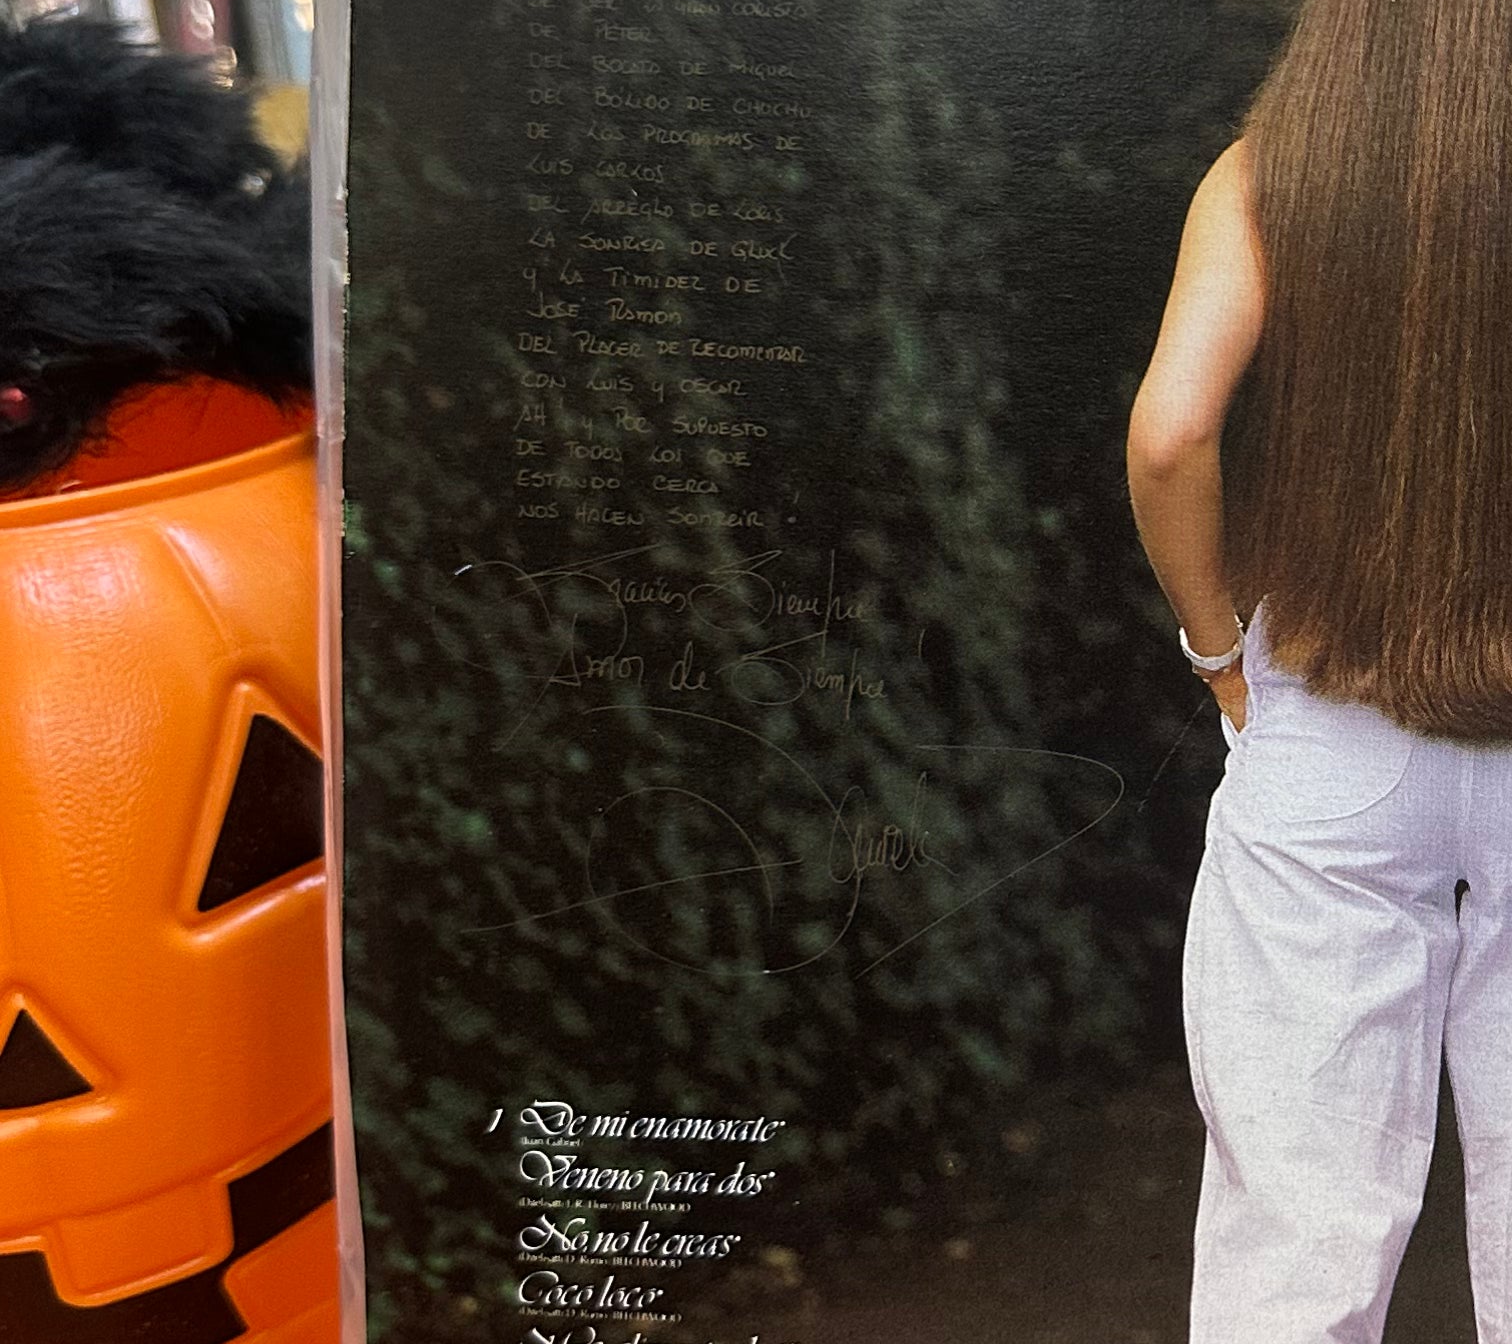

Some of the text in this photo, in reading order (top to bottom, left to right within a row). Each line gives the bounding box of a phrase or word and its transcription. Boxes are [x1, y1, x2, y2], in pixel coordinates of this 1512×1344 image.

[519, 1098, 586, 1137] De
[590, 1109, 632, 1138] mi
[519, 1149, 644, 1192] Veneno
[645, 1169, 717, 1205] para
[716, 1160, 770, 1196] dos
[592, 1228, 631, 1255] no
[632, 1220, 660, 1255] le
[661, 1232, 738, 1258] creas
[517, 1269, 660, 1308] Coco loco
